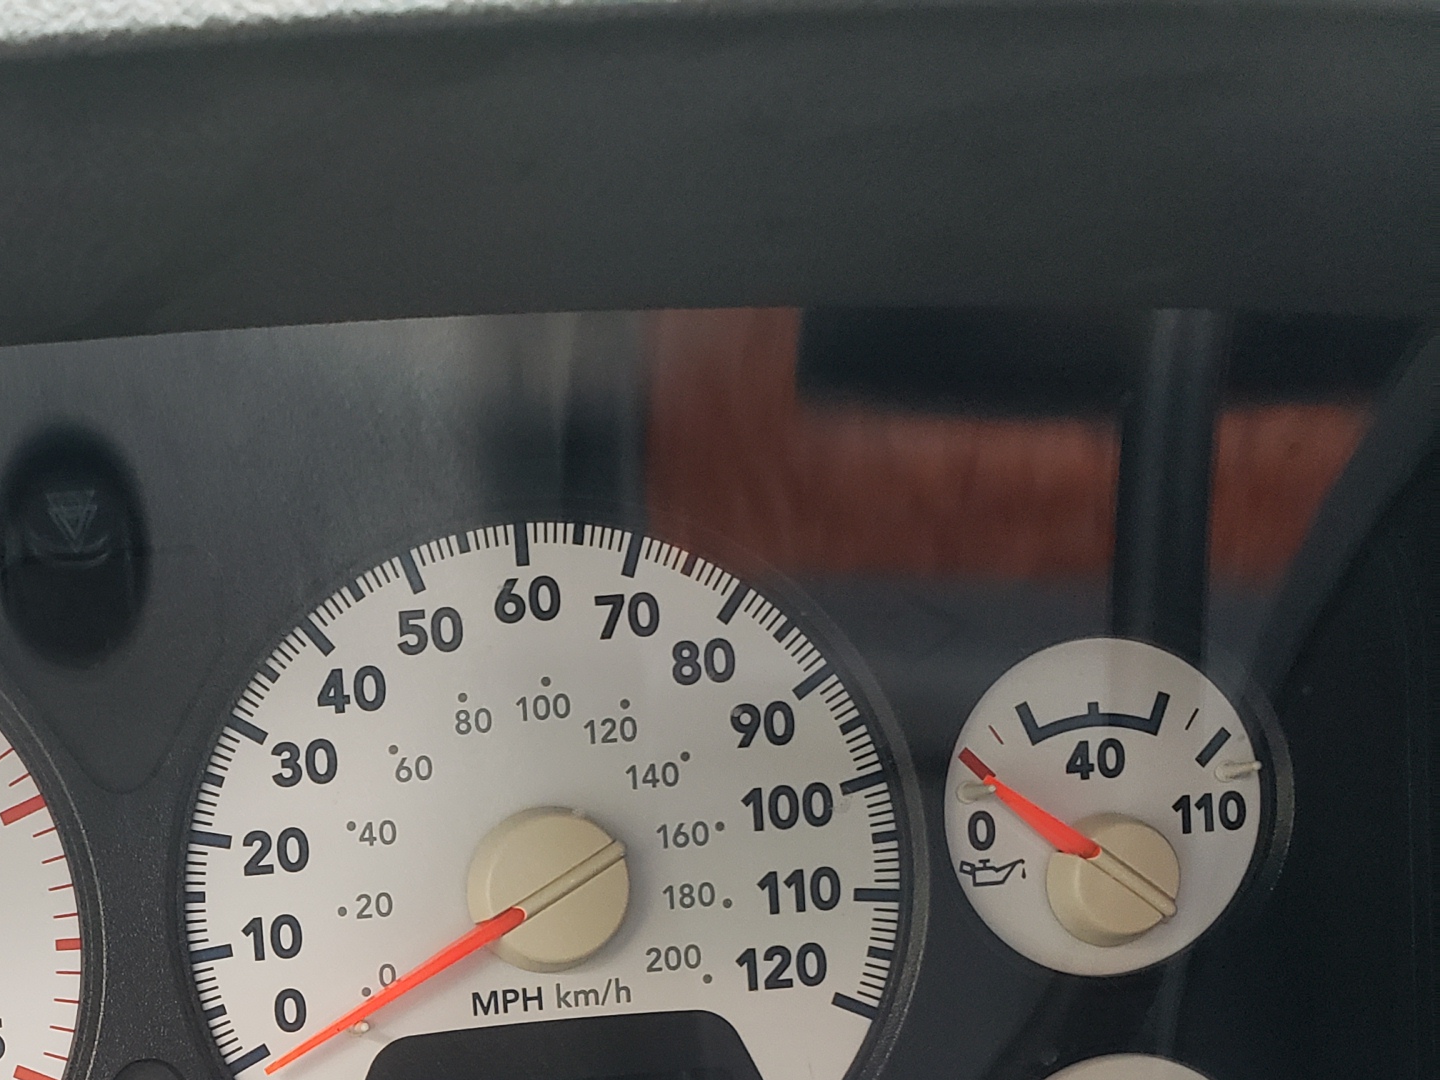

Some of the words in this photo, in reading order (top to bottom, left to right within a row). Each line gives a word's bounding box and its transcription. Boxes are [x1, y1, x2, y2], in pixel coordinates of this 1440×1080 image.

[494, 575, 561, 623] 60
[594, 591, 659, 640] 70
[397, 607, 463, 654] 50
[672, 638, 736, 685] 80
[317, 665, 386, 714] 40
[516, 692, 571, 722] 100
[454, 707, 492, 735] 80
[583, 716, 638, 745] 120
[730, 701, 795, 748] 90
[270, 739, 338, 786] 30
[394, 755, 433, 782] 60
[625, 761, 680, 790] 140
[1066, 738, 1125, 780] 40
[741, 783, 834, 831] 100
[1172, 790, 1246, 834] 110
[242, 827, 309, 875] 20
[359, 819, 397, 846] 40
[657, 821, 709, 849] 160
[967, 810, 996, 851] 0
[356, 892, 393, 919] 20
[663, 882, 716, 910] 180
[758, 866, 841, 914] 110
[242, 914, 302, 961] 10
[646, 945, 702, 972] 200
[378, 963, 397, 989] 0
[736, 942, 827, 990] 120
[274, 988, 307, 1032] 0
[471, 986, 544, 1017] MPH
[555, 980, 632, 1008] km/h
